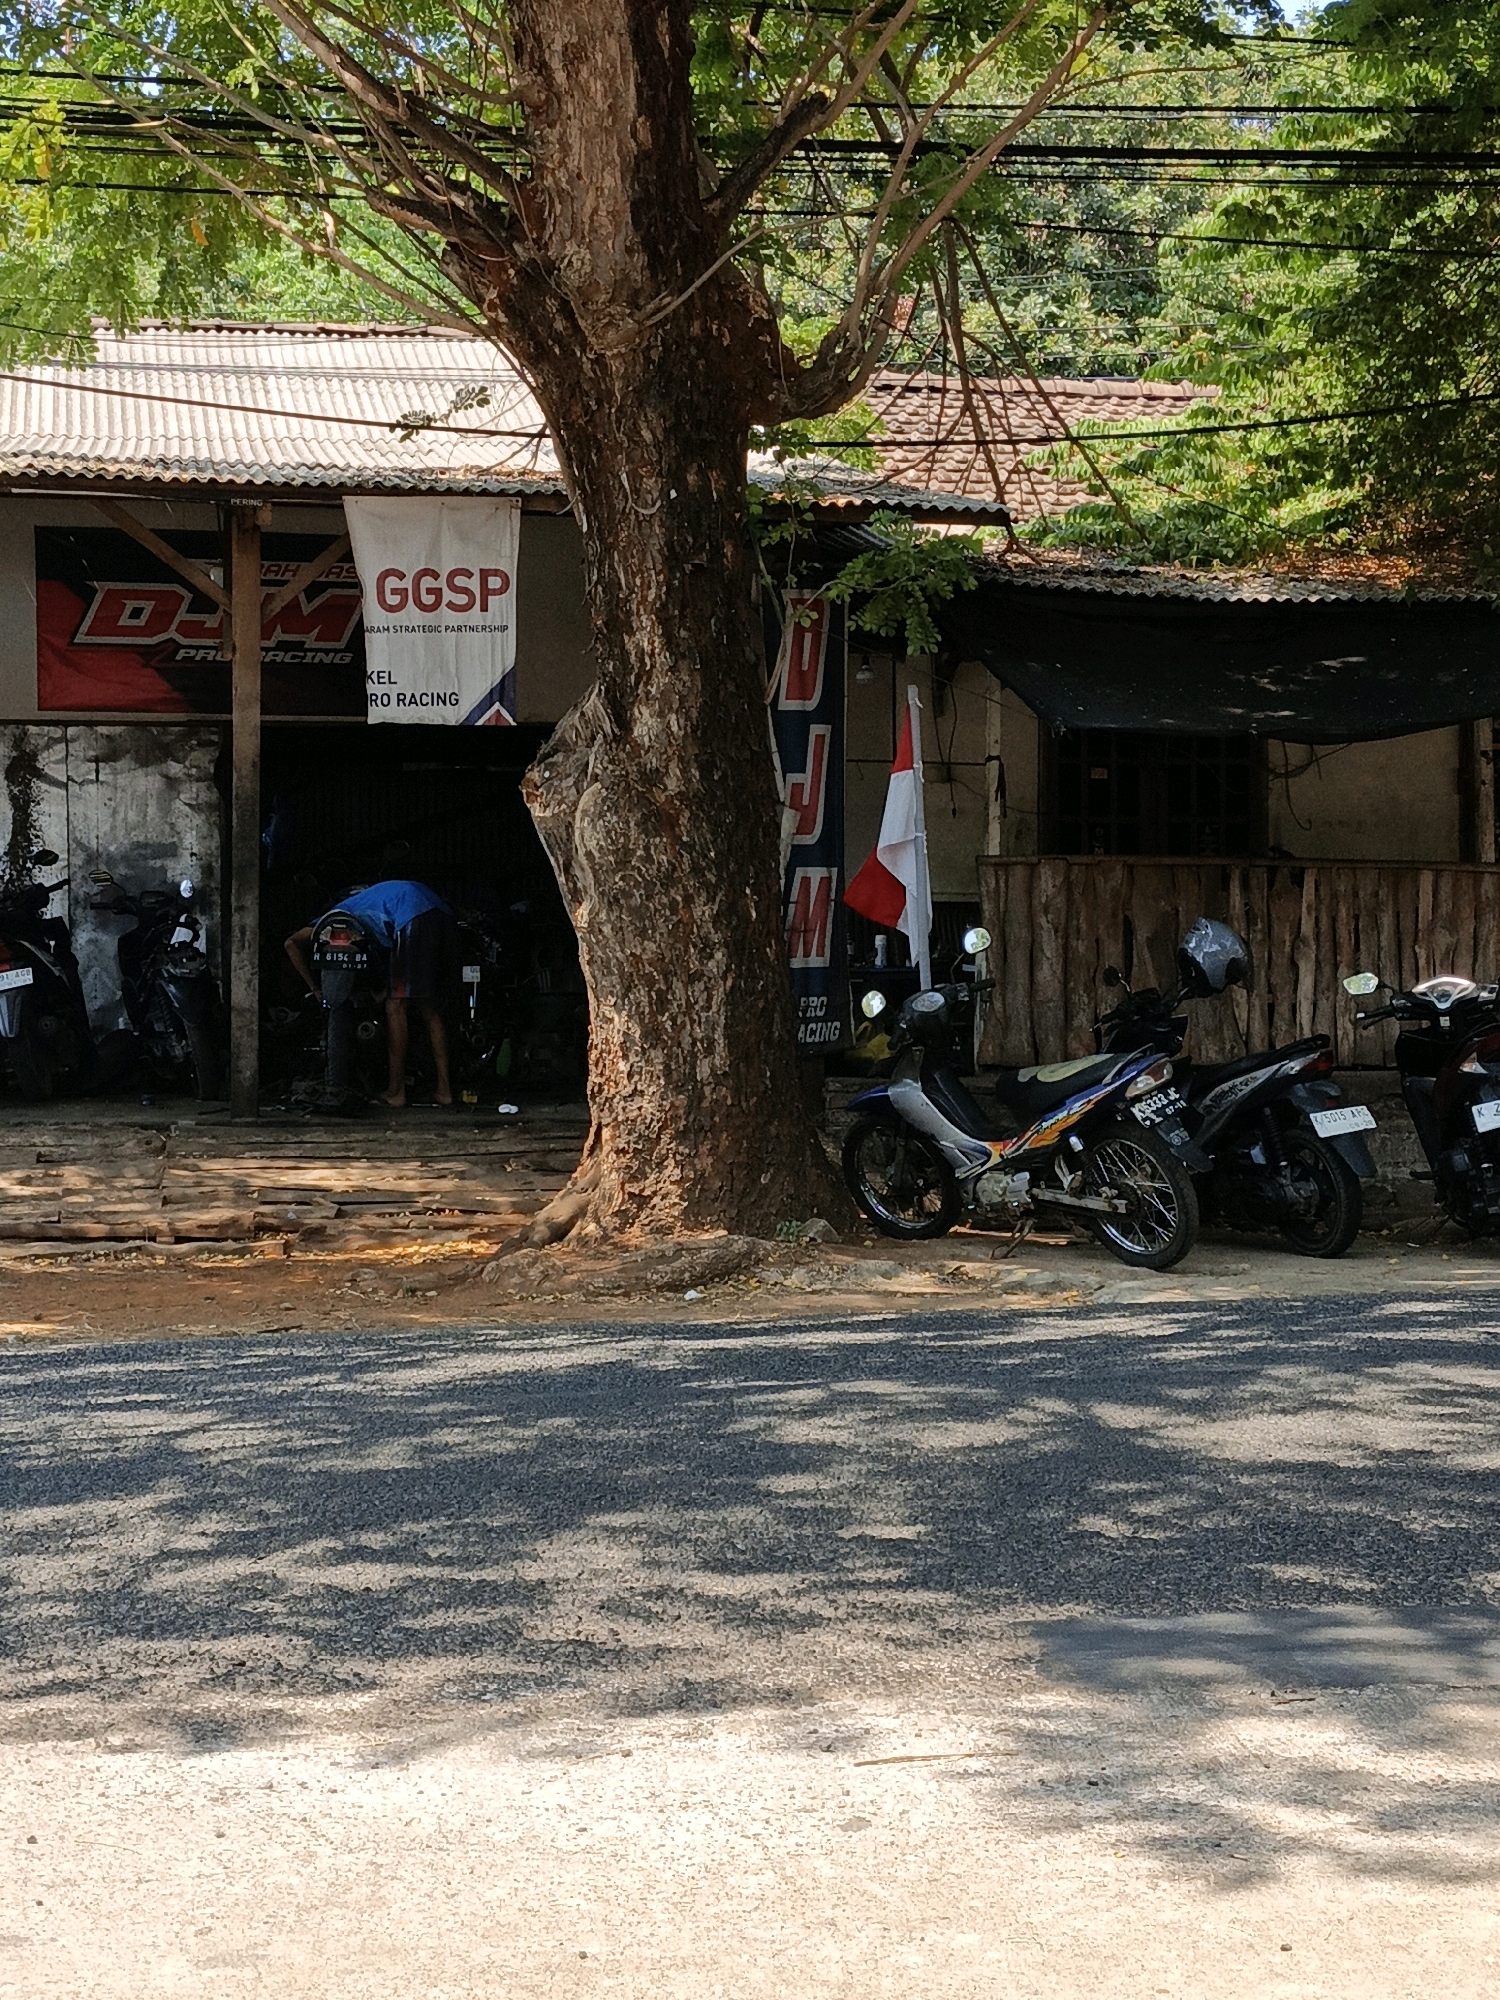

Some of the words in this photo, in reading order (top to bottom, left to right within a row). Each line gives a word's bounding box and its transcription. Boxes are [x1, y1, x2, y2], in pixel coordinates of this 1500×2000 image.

[375, 567, 511, 614] GGSP
[392, 624, 443, 634] STRATEGIC
[444, 624, 509, 634] PARTNERSHIP
[366, 670, 397, 685] KEL
[396, 691, 460, 708] RACING
[1324, 1110, 1348, 1124] 5015
[1476, 1106, 1485, 1119] K
